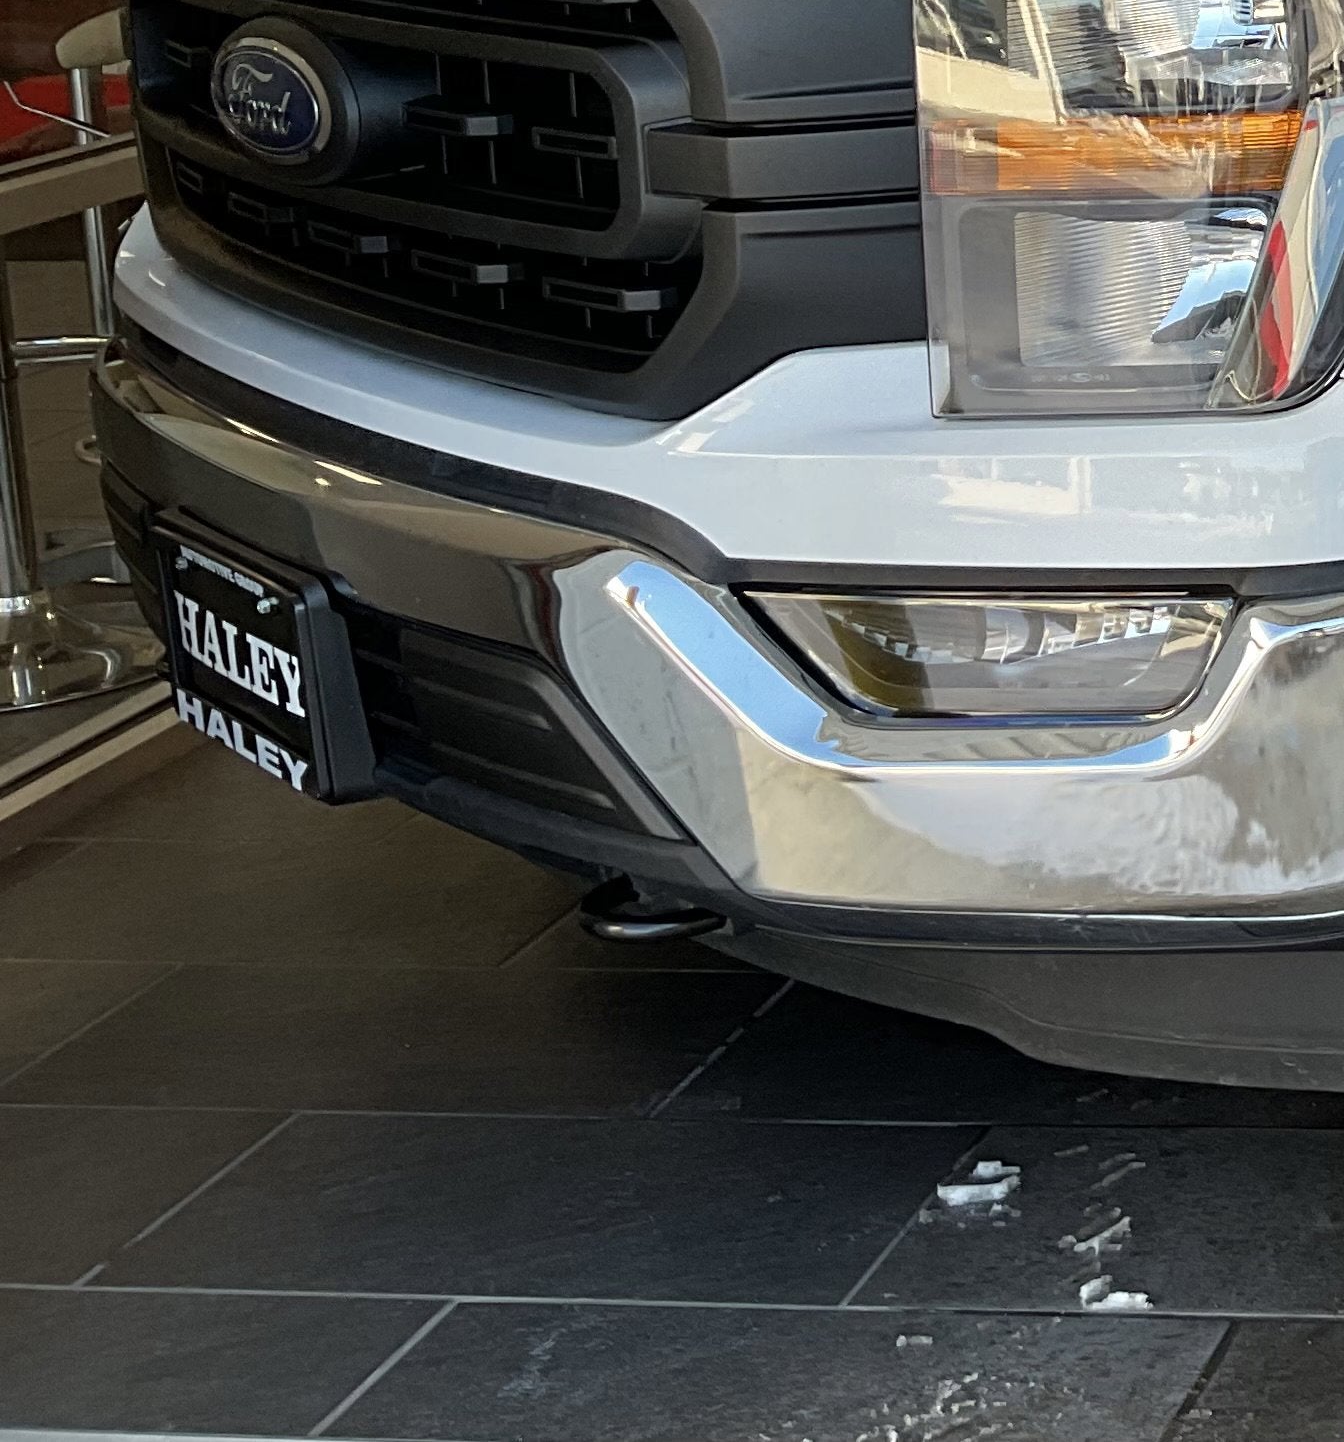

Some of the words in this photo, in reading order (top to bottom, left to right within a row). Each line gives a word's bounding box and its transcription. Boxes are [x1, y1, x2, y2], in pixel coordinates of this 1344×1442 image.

[229, 62, 292, 135] Ford
[173, 590, 306, 718] HALEY
[176, 688, 308, 792] HALEY
